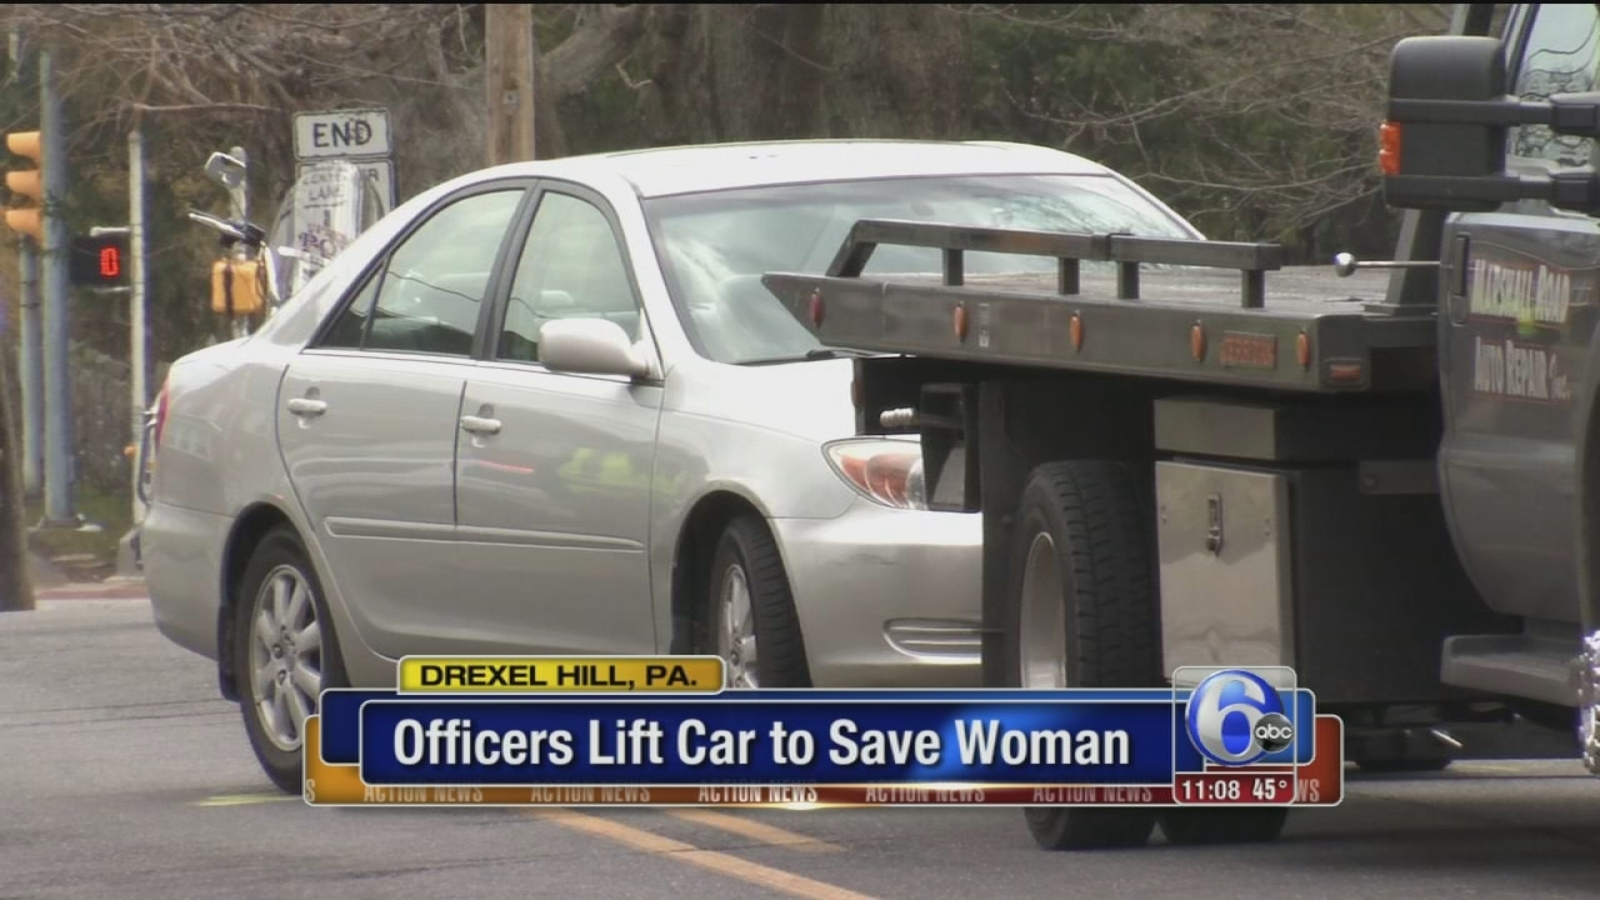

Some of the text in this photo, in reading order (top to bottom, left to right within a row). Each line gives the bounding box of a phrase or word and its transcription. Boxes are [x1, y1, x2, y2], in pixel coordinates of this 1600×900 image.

[313, 120, 373, 148] END
[1475, 336, 1504, 393] AUTO
[1505, 339, 1548, 399] REPAIR
